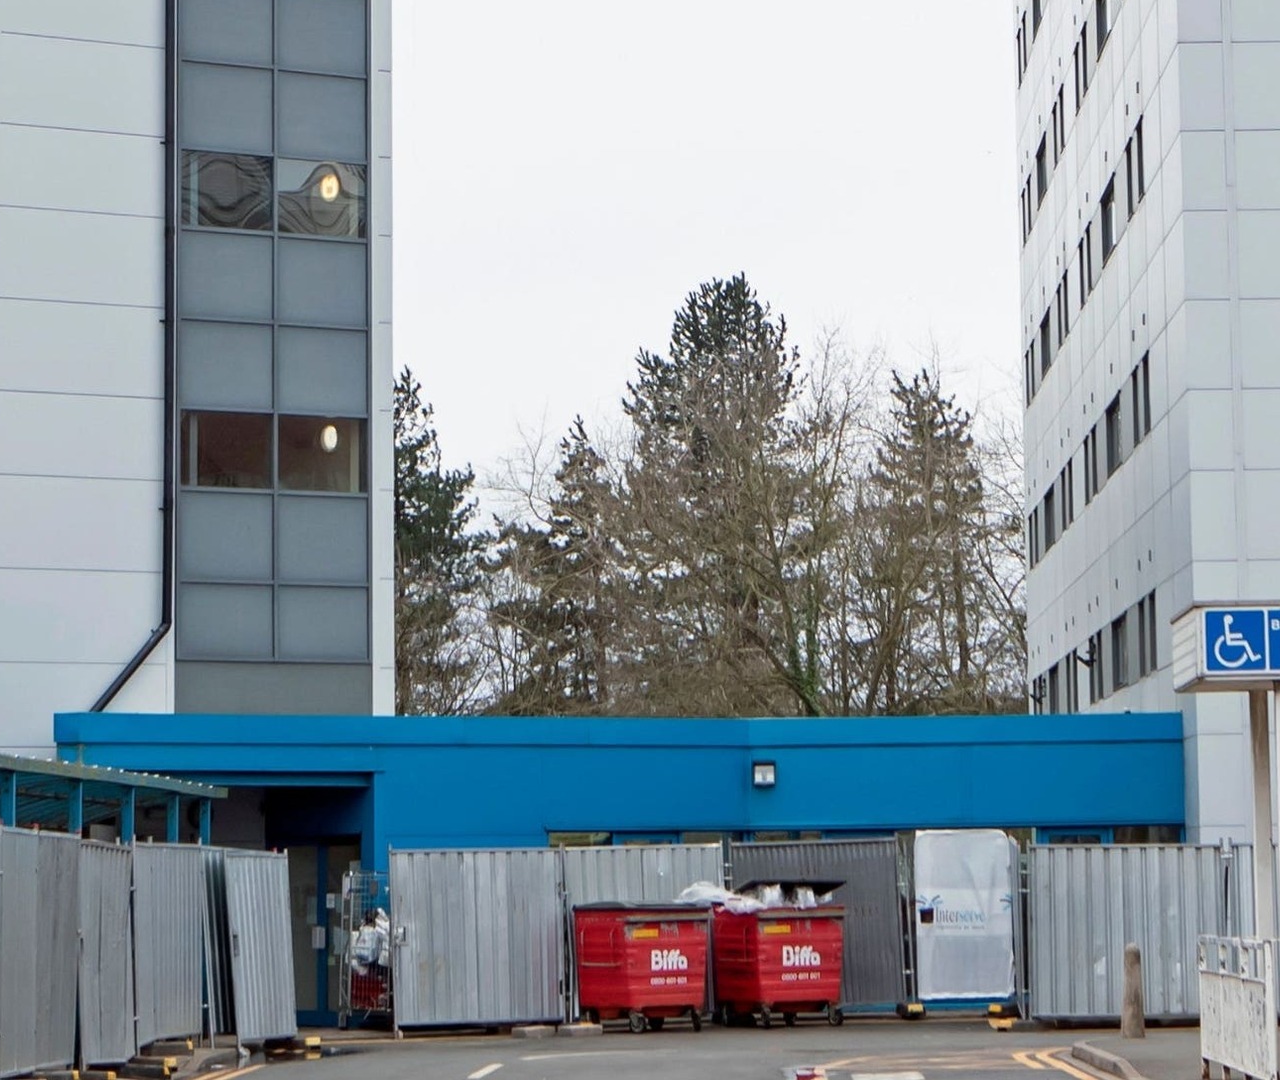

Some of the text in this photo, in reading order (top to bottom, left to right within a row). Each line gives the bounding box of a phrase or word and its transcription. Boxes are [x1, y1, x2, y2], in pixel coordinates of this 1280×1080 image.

[935, 906, 985, 923] Interserve
[651, 949, 688, 970] Biffa
[782, 945, 821, 966] Biffa
